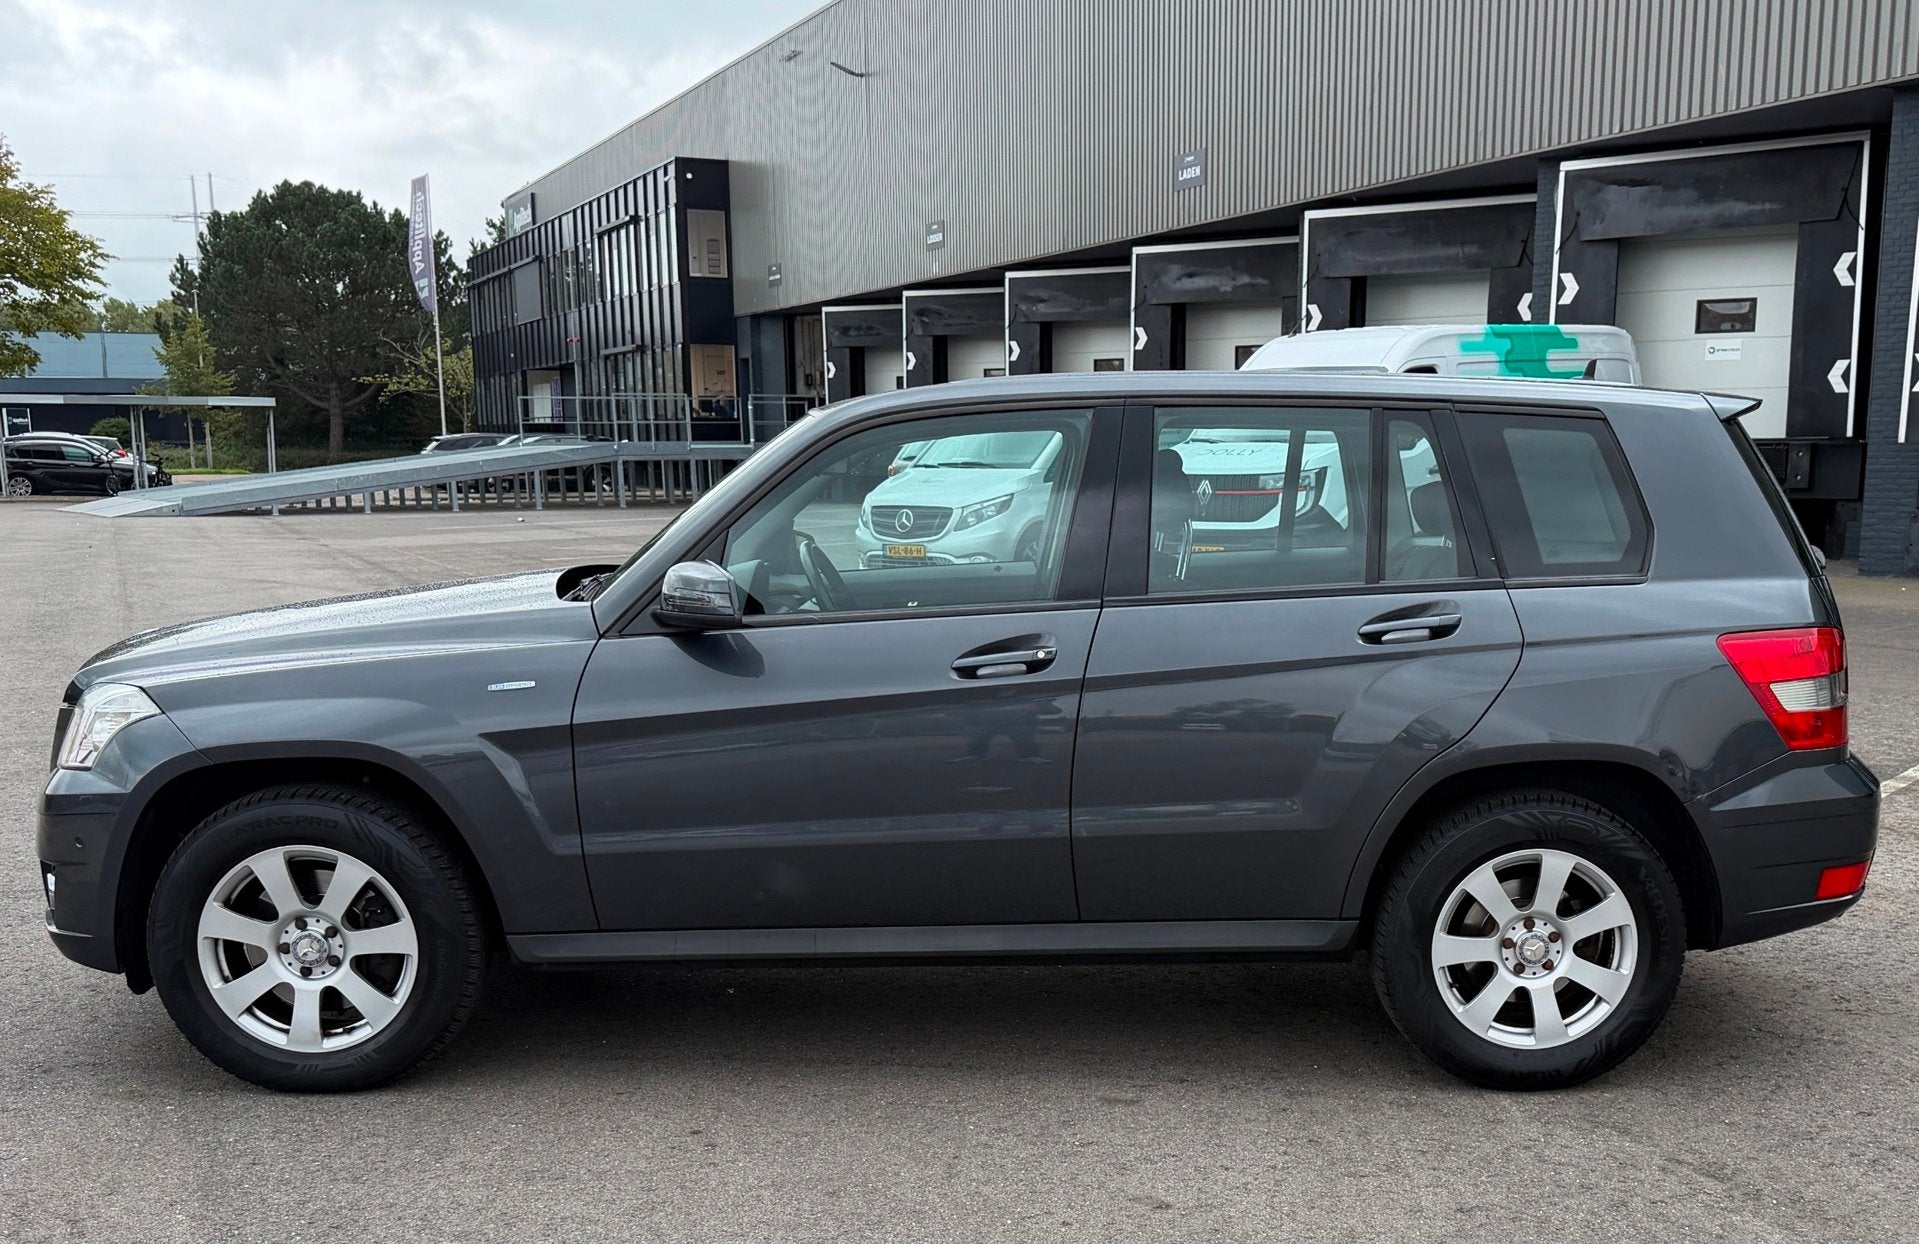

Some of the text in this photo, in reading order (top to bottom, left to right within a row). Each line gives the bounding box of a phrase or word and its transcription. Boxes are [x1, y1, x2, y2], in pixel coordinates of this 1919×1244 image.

[1179, 165, 1201, 181] LADEN
[888, 546, 922, 555] VSL-86-H
[295, 815, 338, 829] PRO
